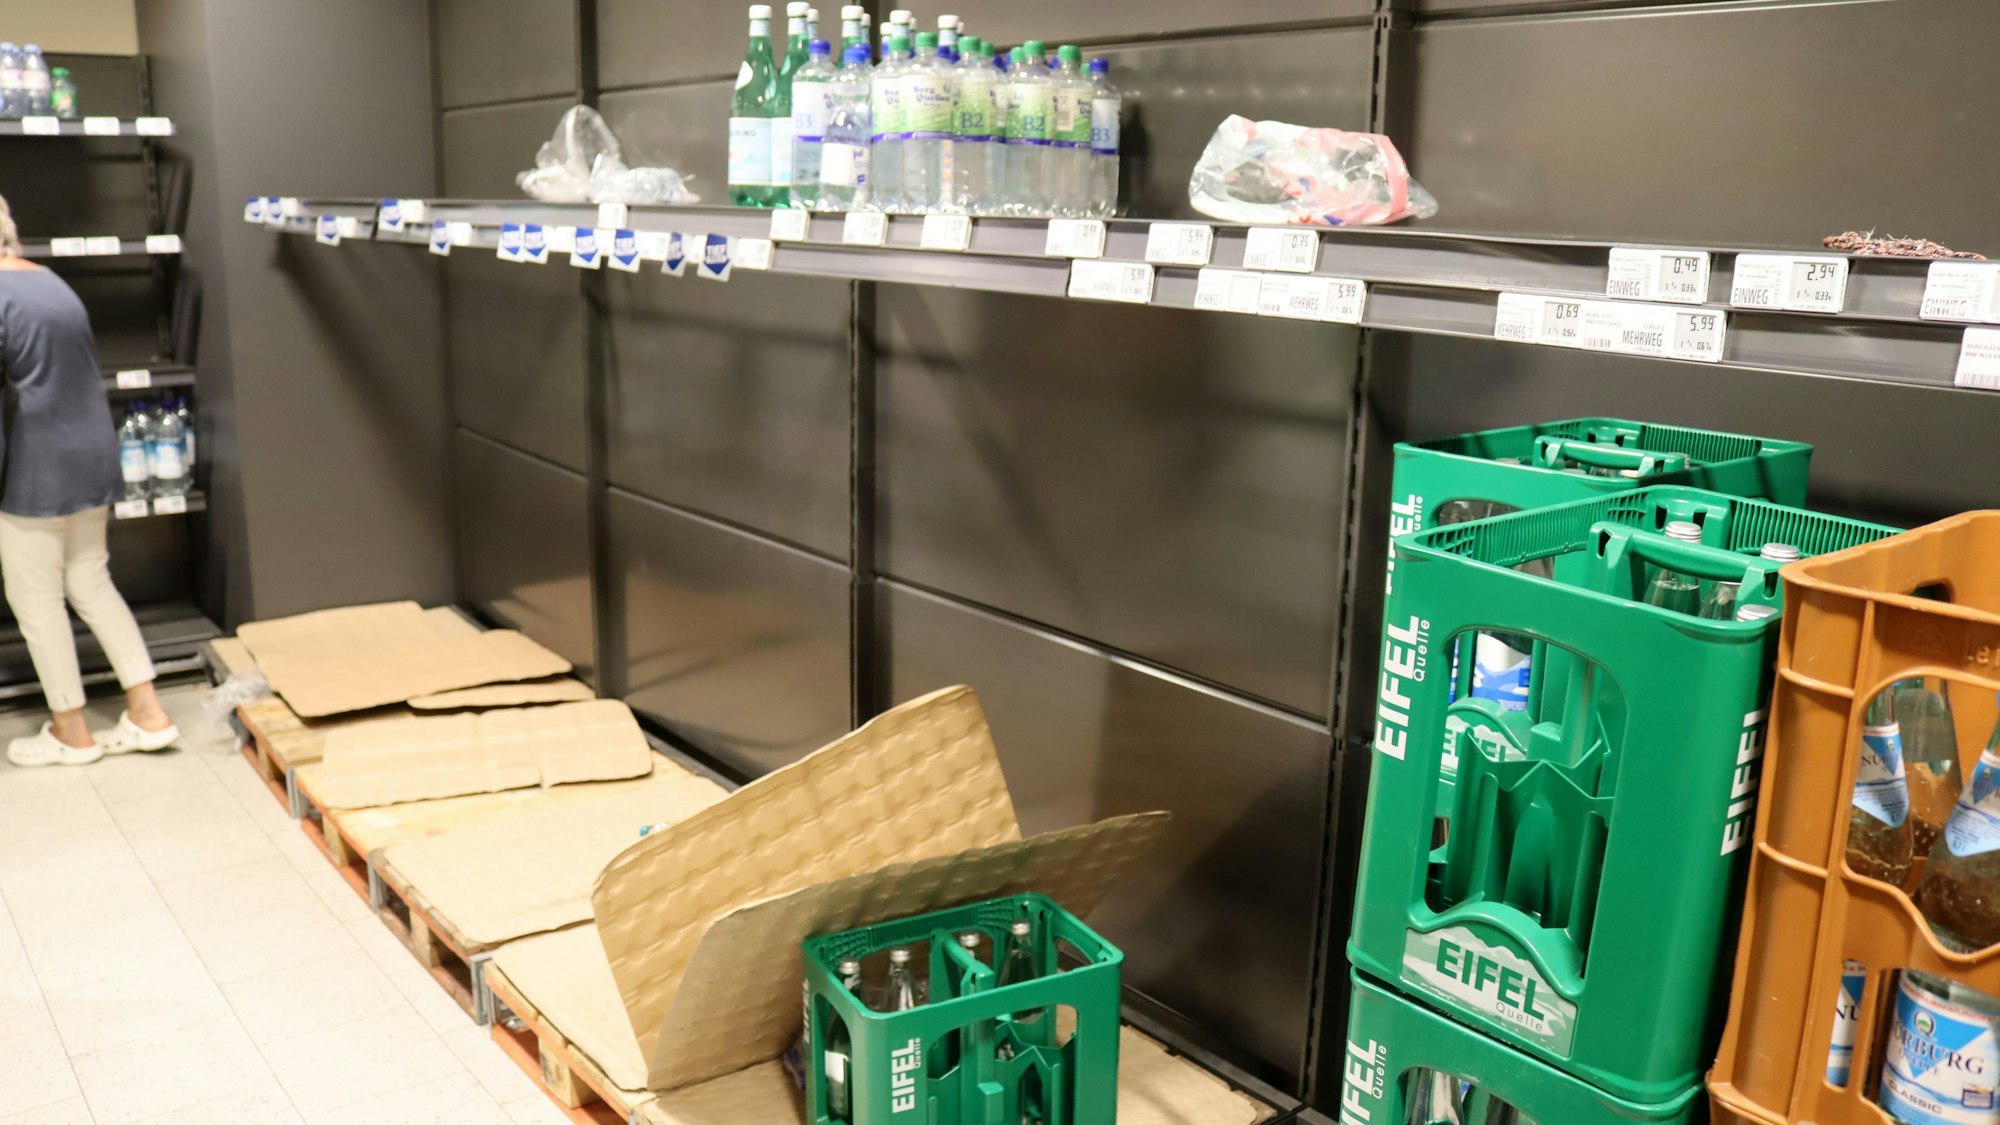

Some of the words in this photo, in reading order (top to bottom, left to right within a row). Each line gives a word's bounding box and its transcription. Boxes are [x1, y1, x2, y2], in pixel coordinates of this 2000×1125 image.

[961, 111, 984, 129] B2
[1023, 115, 1045, 132] B2
[1090, 128, 1110, 142] B3
[1673, 257, 1698, 275] 0.49
[1806, 263, 1836, 281] 2.94
[1337, 285, 1357, 299] 5.99
[1609, 279, 1640, 297] EINWEG
[1733, 287, 1769, 306] EINWEG
[1288, 295, 1320, 312] MEHRWEG
[1556, 304, 1579, 320] 0.69
[1924, 298, 1967, 317] EINWEG
[1690, 315, 1714, 332] 5.99
[1622, 329, 1663, 347] MEHRWEG
[1413, 619, 1430, 682] Quelle
[1375, 615, 1420, 761] EIFEL
[1436, 938, 1545, 1021] EIFEL
[1495, 1001, 1543, 1032] Quelle
[892, 1038, 916, 1114] EIFEL
[1372, 1045, 1387, 1100] Quelle
[1888, 1079, 1943, 1114] CLASSIC
